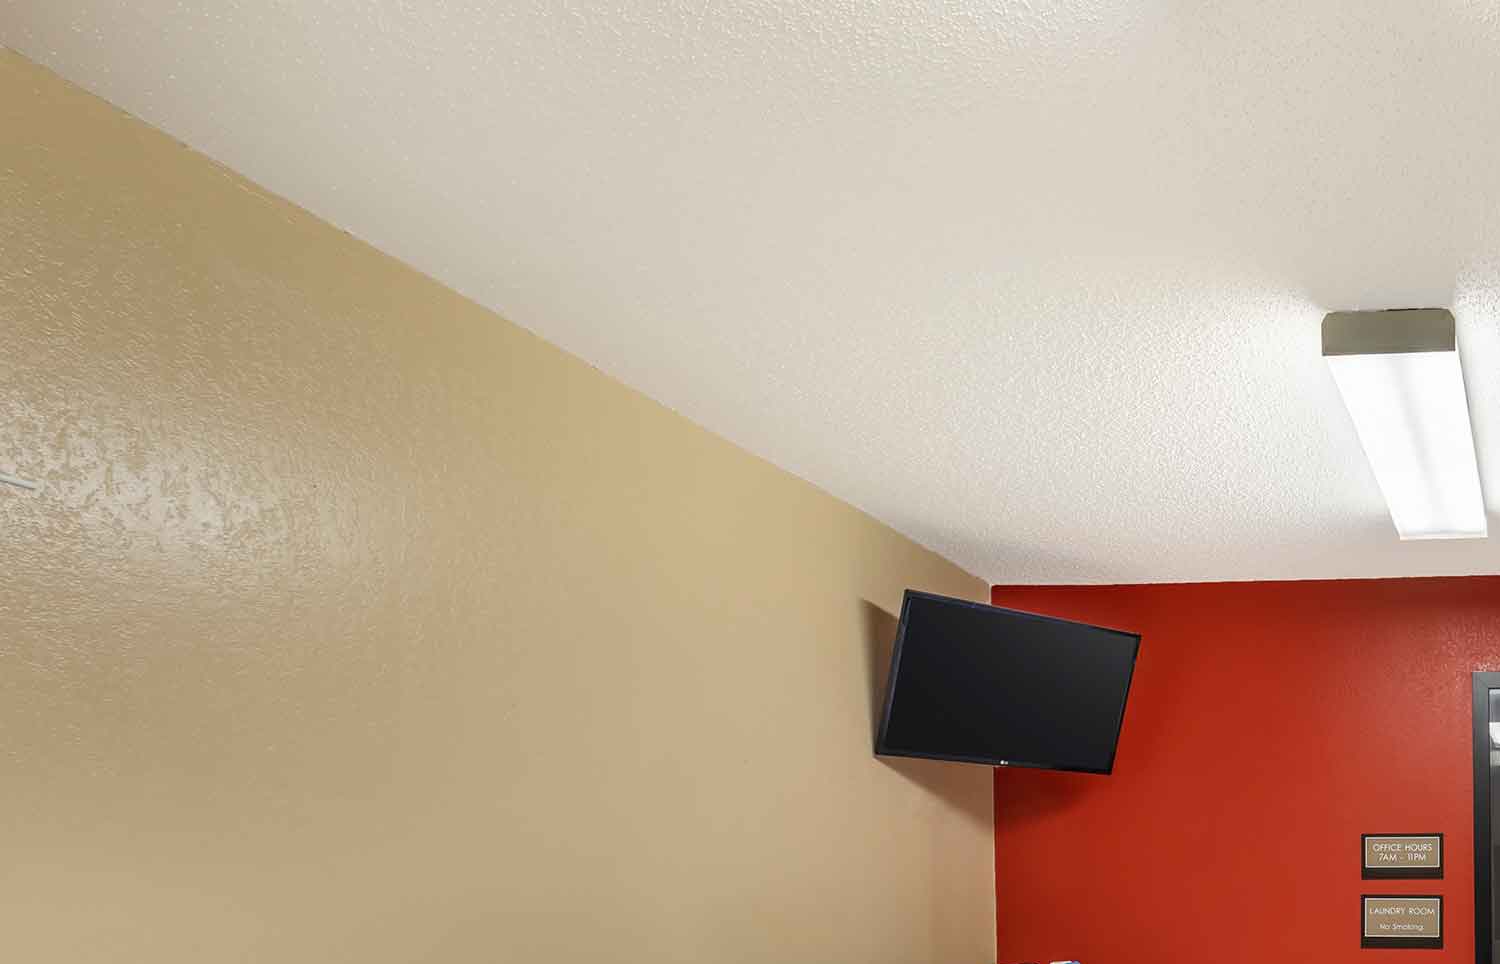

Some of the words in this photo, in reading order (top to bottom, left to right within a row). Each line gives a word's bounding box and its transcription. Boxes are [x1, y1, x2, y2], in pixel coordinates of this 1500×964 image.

[1372, 843, 1401, 852] OFFICE
[1404, 843, 1433, 852] HOURS
[1378, 852, 1398, 861] 7AM
[1369, 907, 1406, 915] LAUNDRY
[1408, 907, 1435, 915] ROOM
